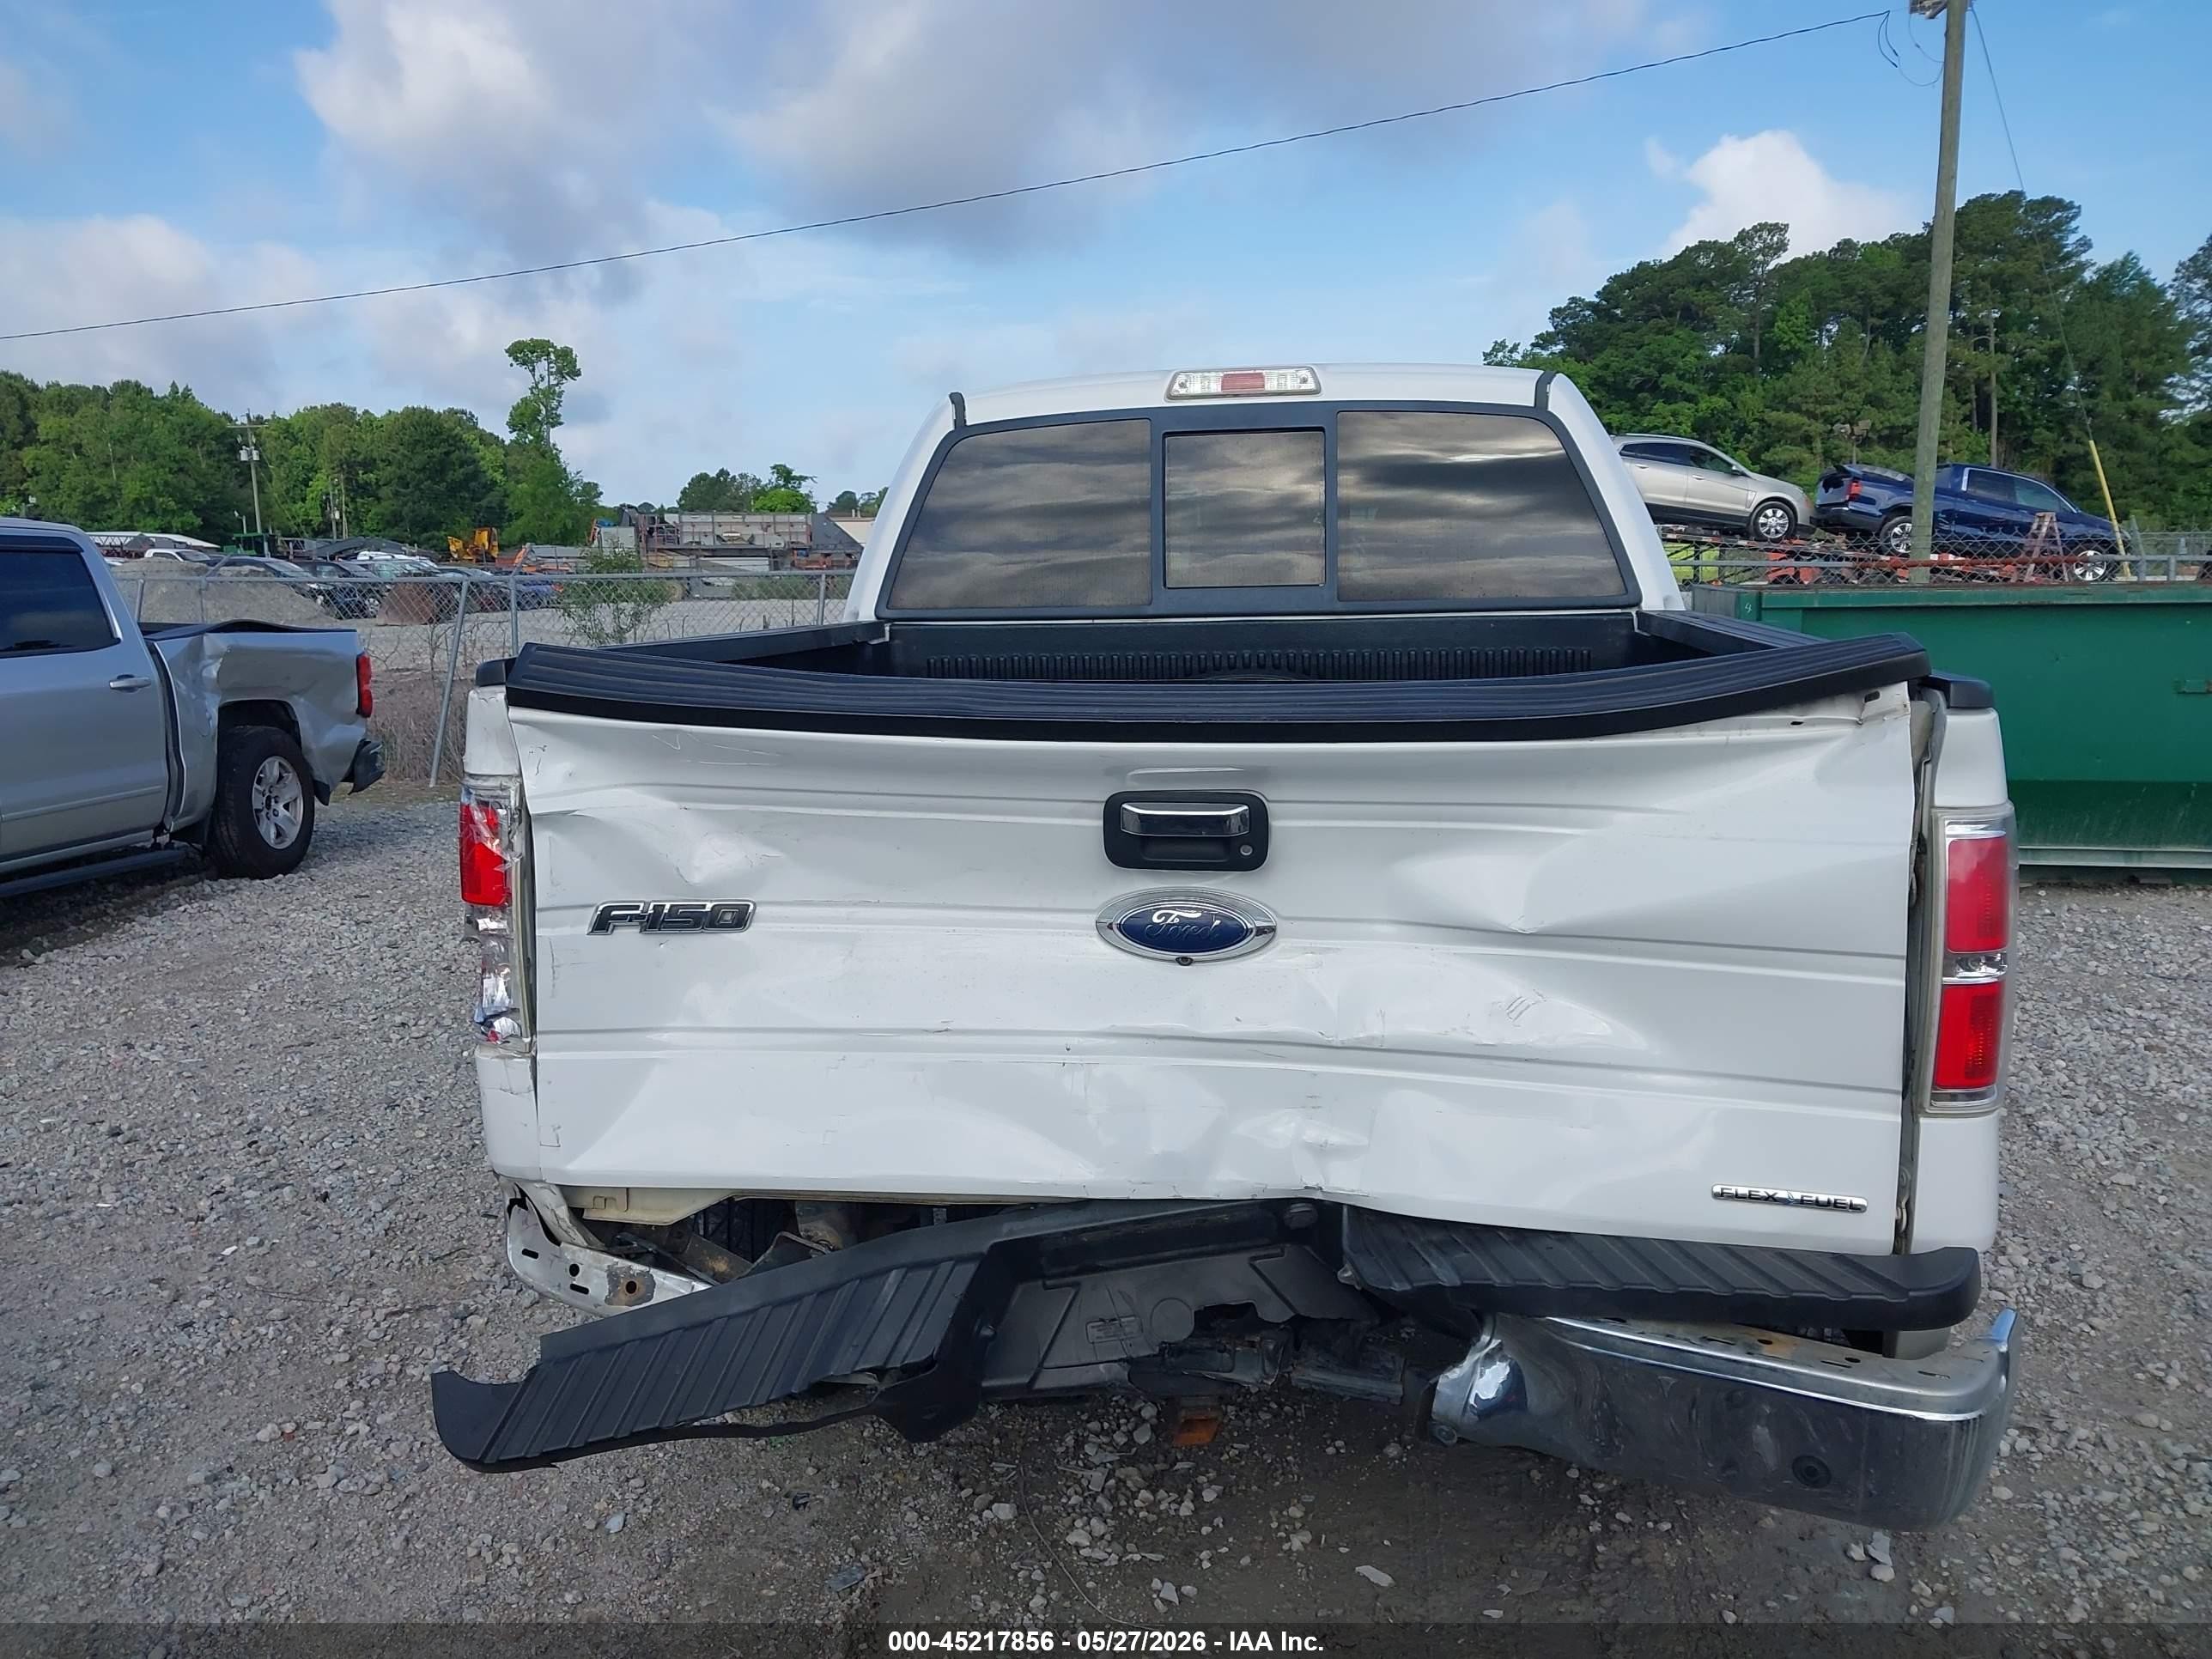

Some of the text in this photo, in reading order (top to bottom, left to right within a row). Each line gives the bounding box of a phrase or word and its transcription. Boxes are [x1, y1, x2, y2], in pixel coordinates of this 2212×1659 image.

[586, 899, 757, 935] F-150
[1144, 908, 1222, 941] Ford
[1719, 1187, 1863, 1212] FLEX FUEL
